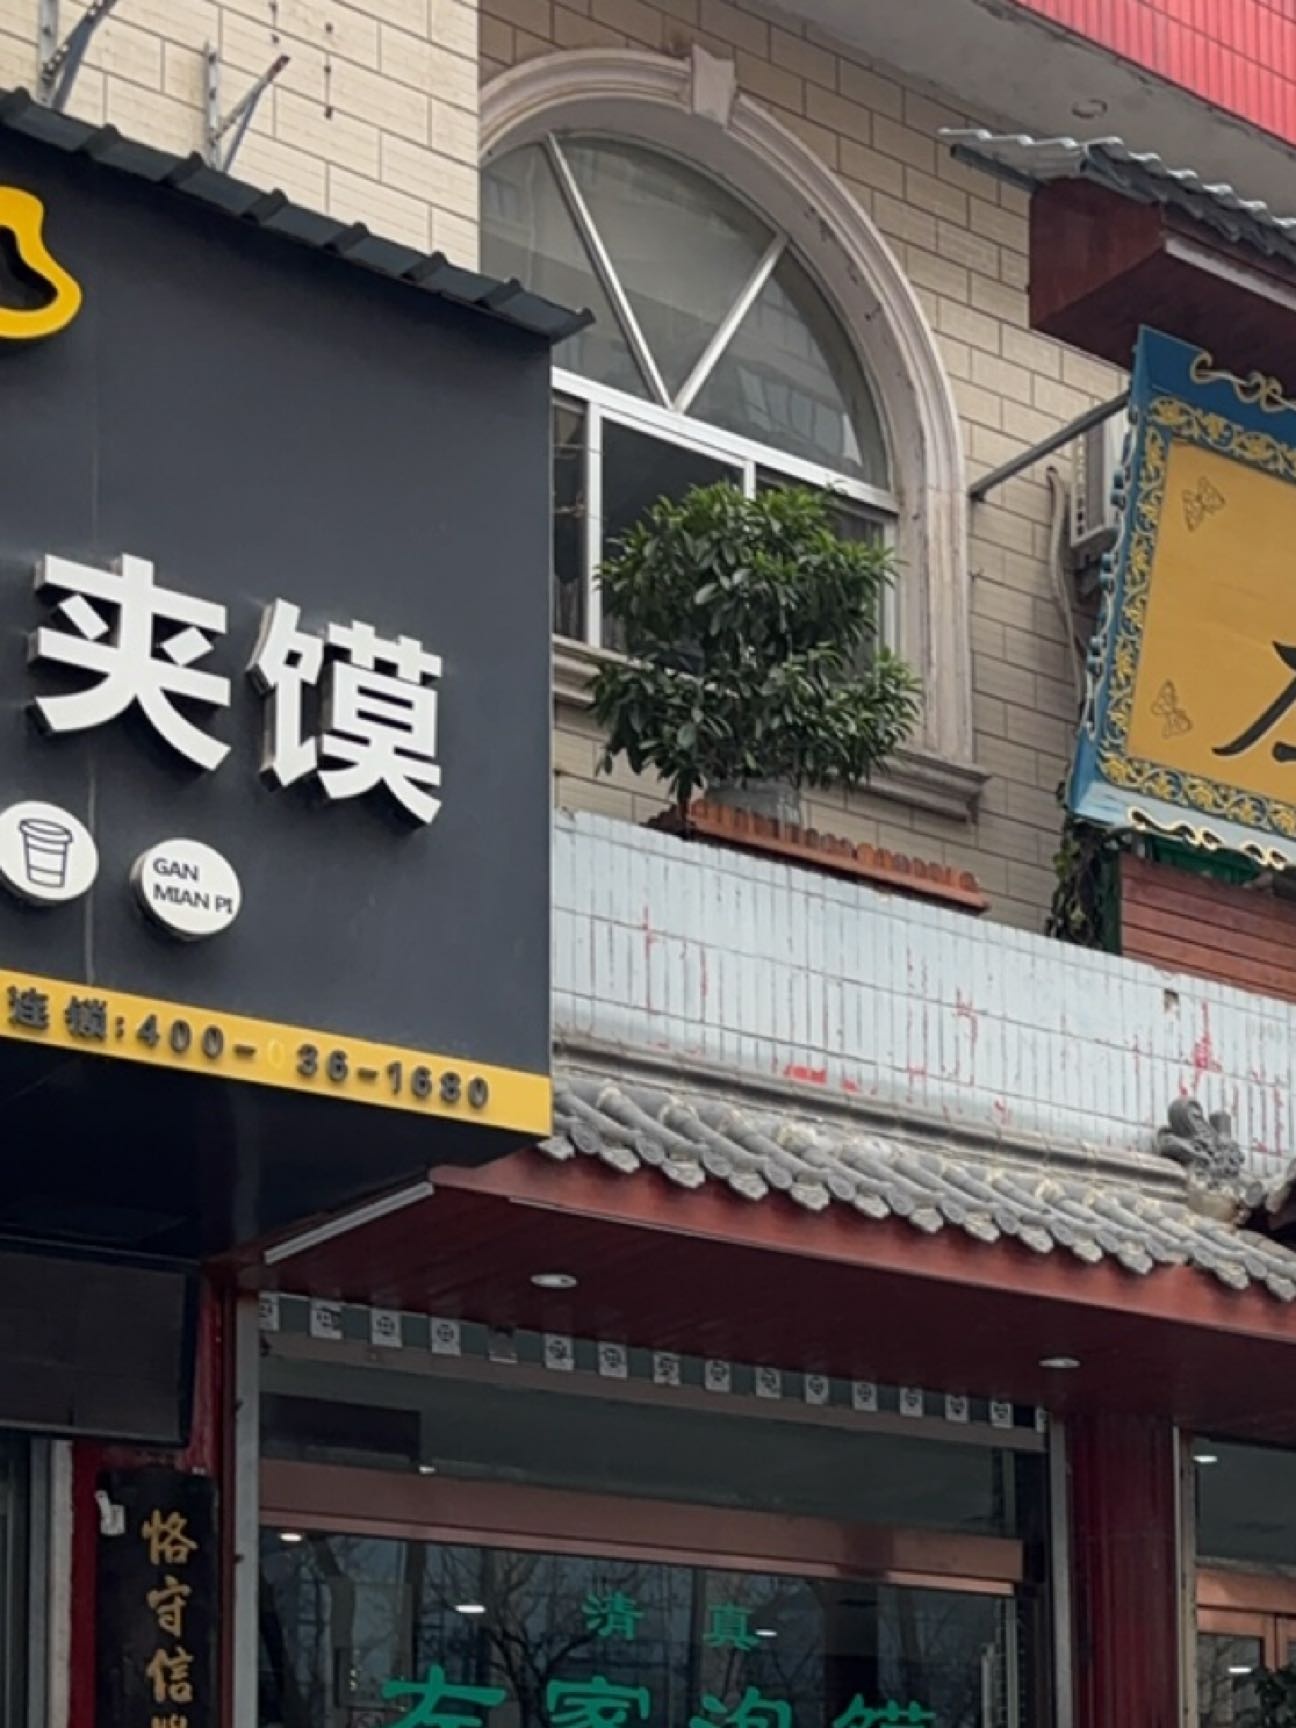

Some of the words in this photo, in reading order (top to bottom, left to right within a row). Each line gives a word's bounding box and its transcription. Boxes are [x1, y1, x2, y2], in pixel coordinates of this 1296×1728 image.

[33, 553, 442, 825] 夹馍
[153, 858, 198, 881] GAN
[153, 883, 210, 911] MIAN
[215, 894, 233, 915] PI
[580, 1590, 759, 1652] 清真
